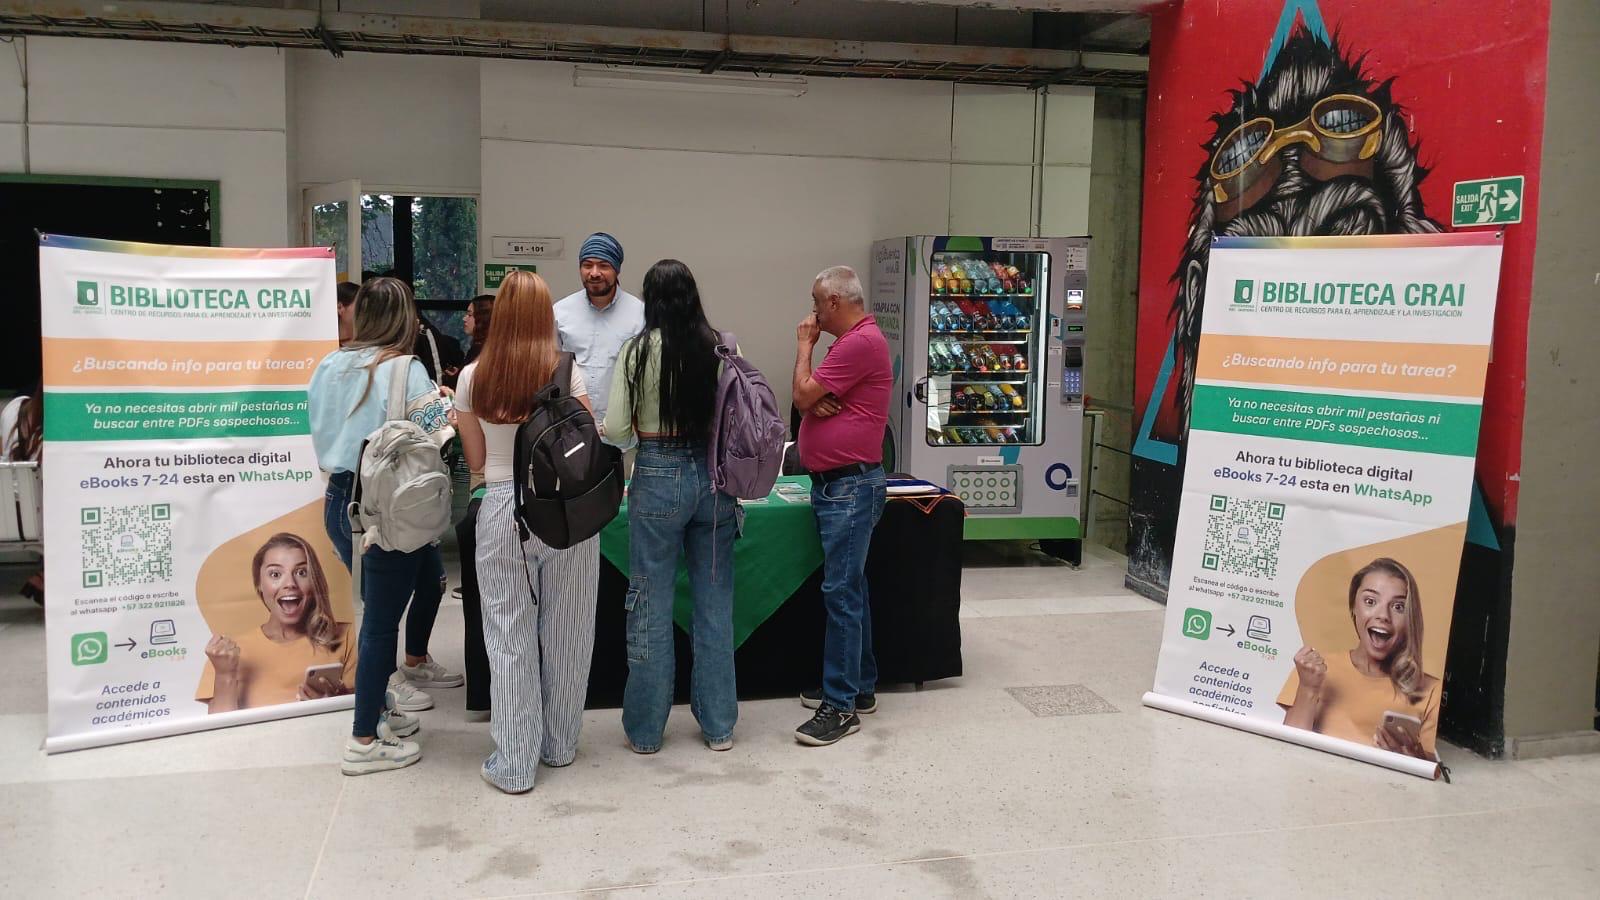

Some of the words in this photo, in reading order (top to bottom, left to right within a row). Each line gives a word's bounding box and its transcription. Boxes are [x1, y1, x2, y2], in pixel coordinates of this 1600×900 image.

[1456, 193, 1479, 204] SALIDA
[1461, 204, 1473, 212] EXIT
[110, 285, 250, 310] BIBLIOTECA
[257, 288, 311, 309] CRAI
[1262, 281, 1396, 306] BIBLIOTECA
[1404, 283, 1465, 307] CRAI
[1294, 306, 1326, 314] RECURSOS
[1327, 307, 1343, 315] PARA
[1353, 308, 1396, 316] APRENDIZAJE
[72, 356, 167, 373] ¿Buscando
[171, 358, 202, 374] info
[205, 360, 242, 375] para
[246, 359, 262, 370] tu
[265, 358, 314, 370] tarea?
[1222, 353, 1305, 370] ¿Buscando
[1307, 357, 1336, 375] info
[1339, 362, 1377, 377] para
[1380, 363, 1397, 376] tu
[1401, 363, 1456, 378] tarea?
[85, 403, 101, 414] Ya
[105, 405, 121, 414] no
[125, 402, 185, 414] necesitas
[188, 402, 216, 413] abrir
[220, 402, 238, 412] mil
[240, 401, 293, 414] pestañas
[296, 401, 307, 411] ni
[1228, 397, 1244, 408] Ya
[1243, 400, 1257, 409] no
[1260, 400, 1314, 415] necesitas
[1316, 405, 1344, 417] abrir
[1347, 407, 1366, 419] mil
[1367, 410, 1425, 424] pestañas
[1428, 414, 1441, 425] ni
[93, 418, 139, 429] buscar
[142, 418, 175, 428] entre
[178, 417, 210, 427] PDFs
[213, 415, 300, 429] sospechosos...
[1232, 412, 1270, 426] buscar
[1273, 418, 1302, 429] entre
[1304, 419, 1335, 432] PDFs
[1338, 423, 1429, 440] sospechosos...
[104, 455, 151, 469] Ahora
[155, 455, 170, 467] tu
[174, 452, 245, 466] biblioteca
[248, 452, 291, 467] digital
[1235, 451, 1275, 468] Ahora
[1278, 455, 1292, 468] tu
[1295, 457, 1363, 476] biblioteca
[1367, 464, 1413, 482] digital
[80, 474, 138, 489] eBooks
[143, 473, 179, 486] 7-24
[183, 473, 214, 484] esta
[218, 473, 235, 483] en
[238, 468, 313, 483] WhatsApp
[1213, 466, 1262, 484] eBooks
[1265, 472, 1297, 487] 7-24
[1299, 478, 1329, 490] esta
[1332, 483, 1350, 494] en
[1354, 484, 1433, 507] WhatsApp
[1193, 576, 1219, 587] Escanea
[1226, 582, 1248, 593] código
[1254, 588, 1280, 598] escribe
[1195, 586, 1225, 597] whatsapp
[74, 597, 108, 606] Escanea
[119, 593, 145, 602] código
[152, 591, 179, 599] escribe
[79, 606, 118, 615] whatsapp
[140, 646, 187, 659] eBooks
[1236, 640, 1278, 656] eBooks
[1199, 661, 1240, 678] Accede
[1242, 672, 1249, 680] a
[101, 681, 149, 695] Accede
[152, 681, 161, 690] a
[1193, 674, 1253, 695] contenidos
[96, 694, 166, 710] contenidos
[1188, 686, 1254, 708] académicos
[92, 707, 171, 725] académicos
